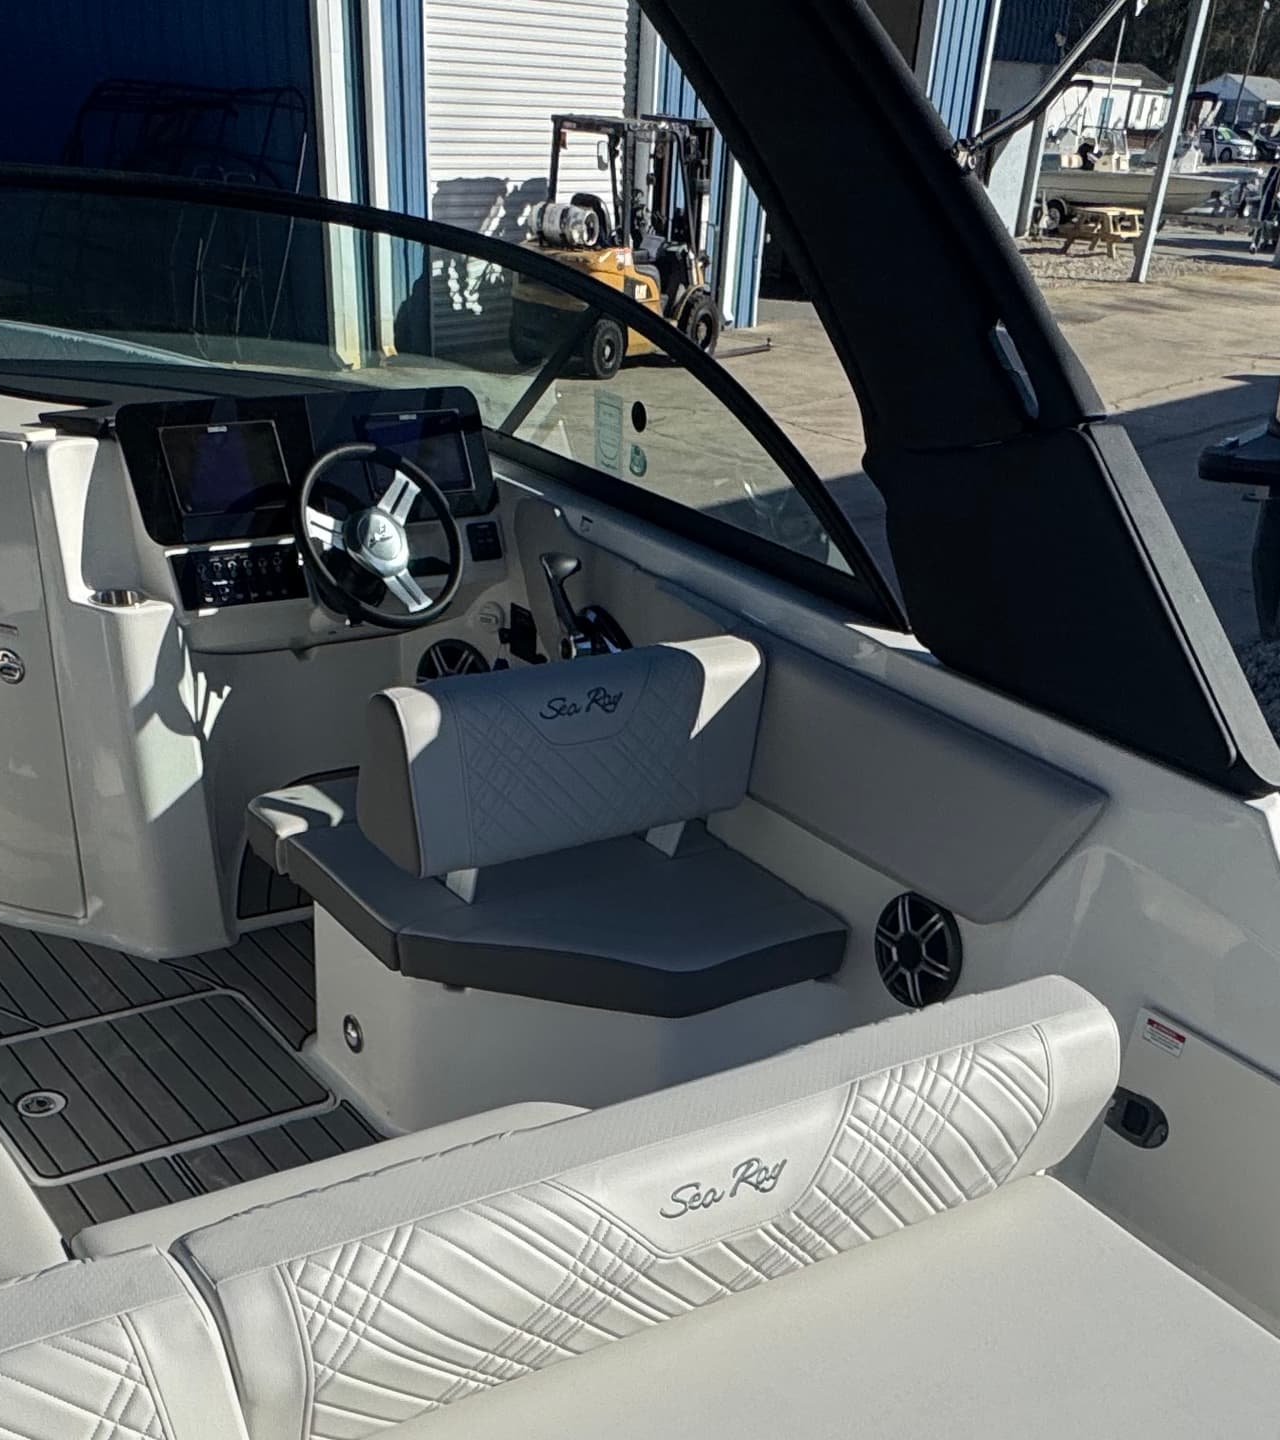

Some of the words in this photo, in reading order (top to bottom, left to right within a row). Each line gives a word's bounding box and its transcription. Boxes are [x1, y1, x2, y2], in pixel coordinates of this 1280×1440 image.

[539, 697, 582, 720] Sea
[585, 687, 623, 714] Ray
[659, 1181, 725, 1219] Sea
[729, 1157, 787, 1199] Ray
